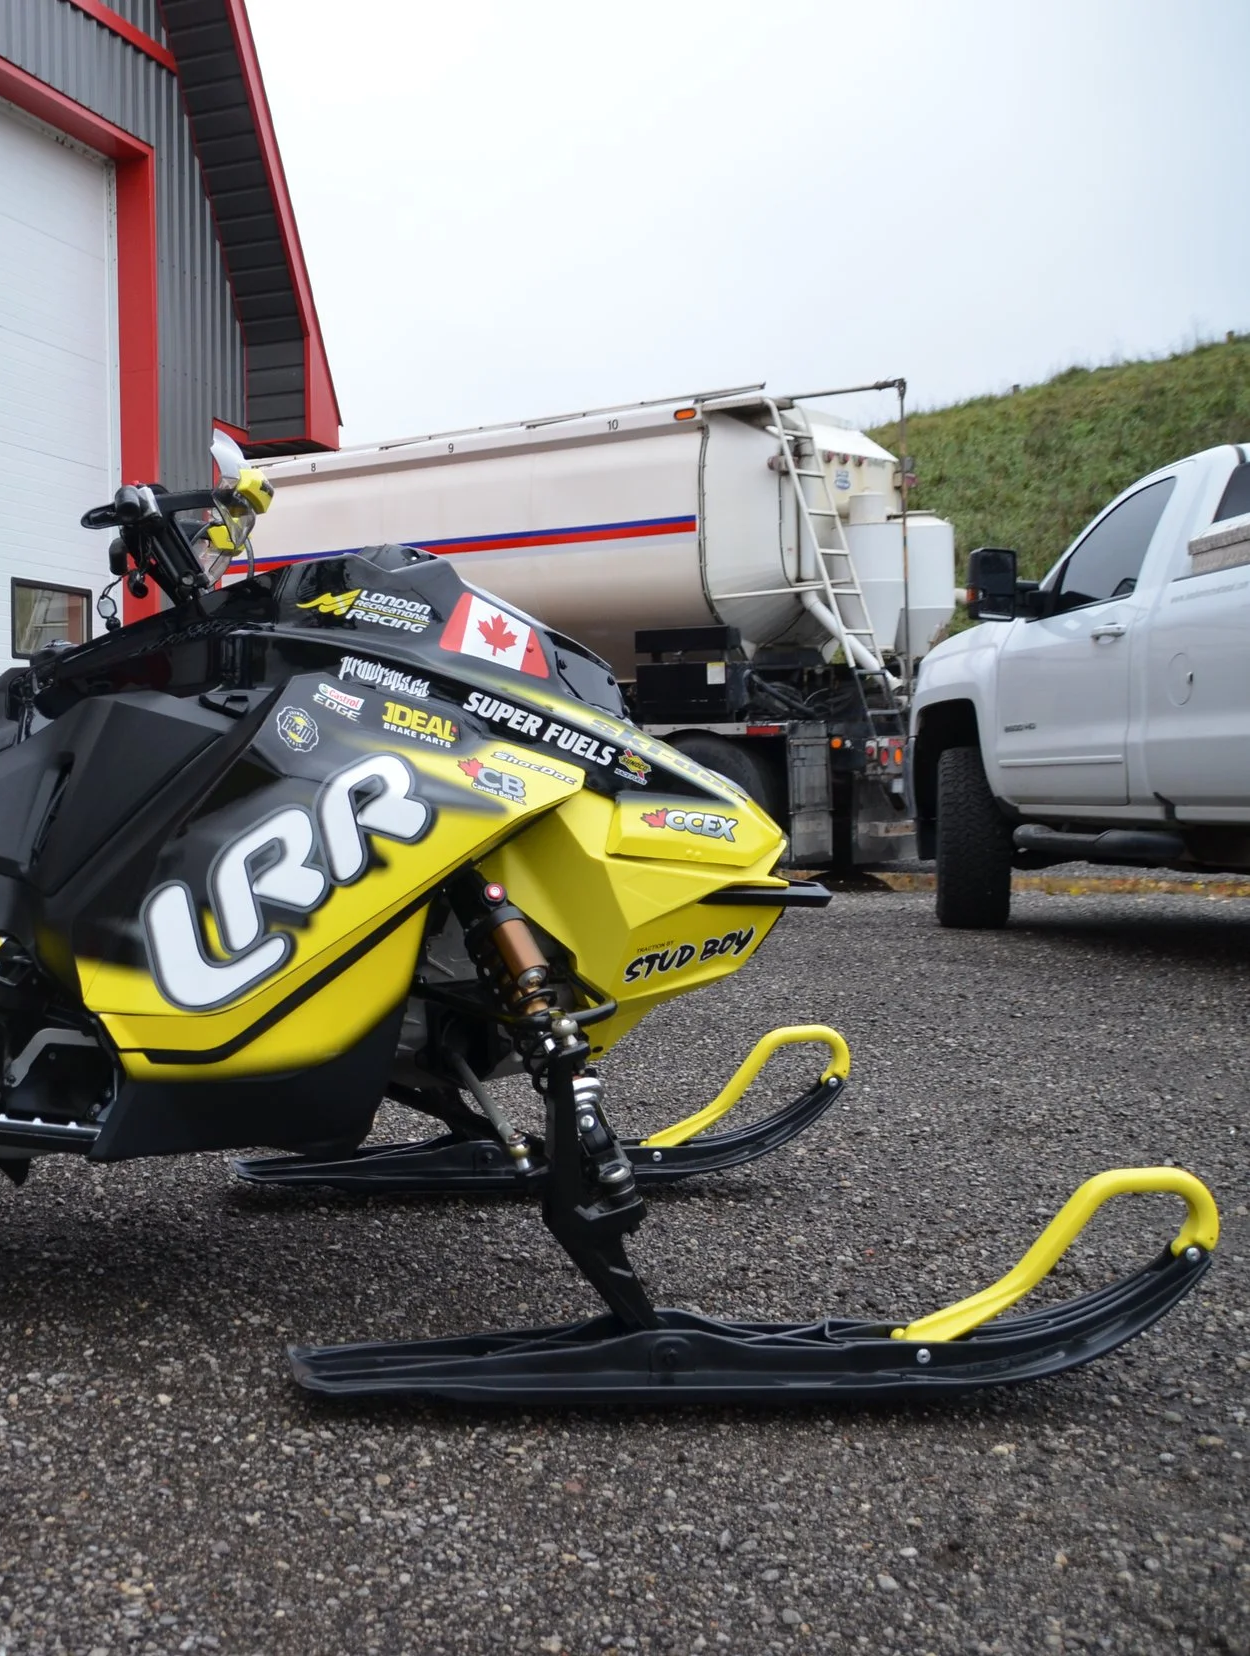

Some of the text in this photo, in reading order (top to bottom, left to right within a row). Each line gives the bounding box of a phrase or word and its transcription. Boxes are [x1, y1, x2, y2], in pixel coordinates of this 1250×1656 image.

[607, 420, 618, 431] 10
[448, 443, 454, 453] 9
[311, 462, 316, 472] 8
[313, 693, 362, 723] EDGE
[329, 689, 360, 708] Castrol
[383, 722, 452, 748] BRAKE PARTS
[463, 692, 616, 766] SUPER FUELS
[477, 766, 526, 798] CB
[664, 810, 738, 842] CCEX
[140, 751, 433, 1012] LRR
[623, 926, 755, 982] STUD BOY
